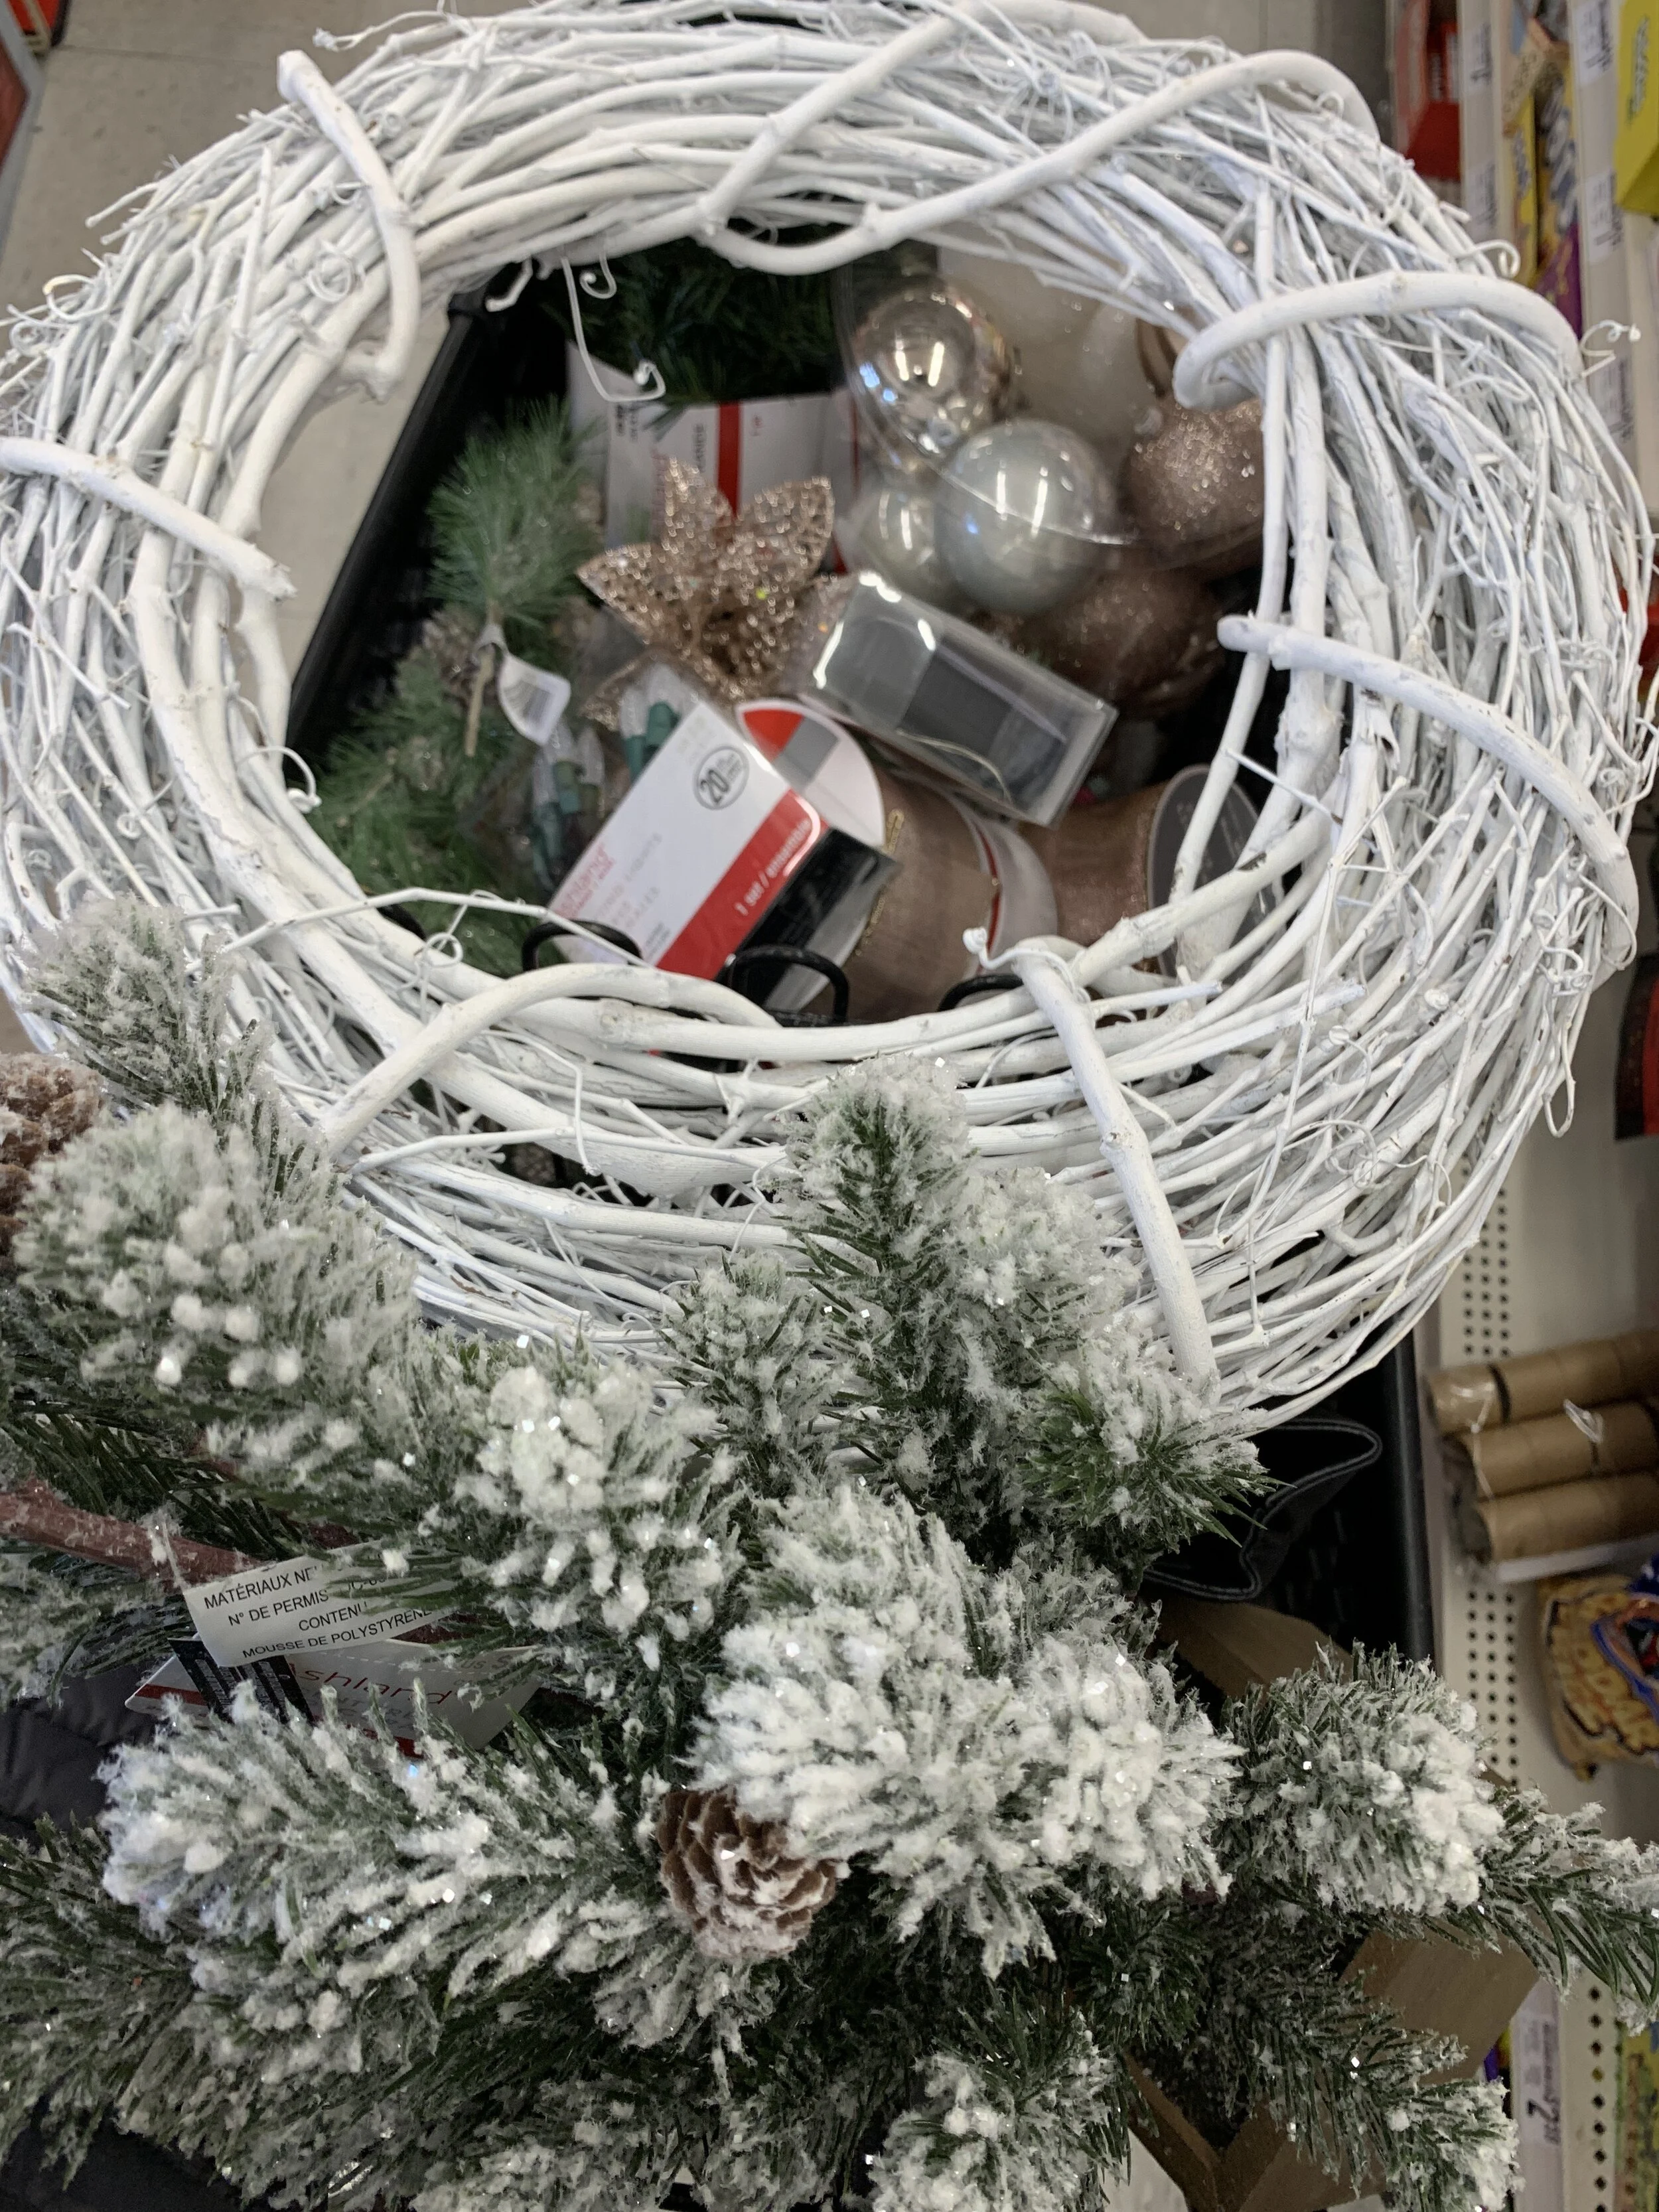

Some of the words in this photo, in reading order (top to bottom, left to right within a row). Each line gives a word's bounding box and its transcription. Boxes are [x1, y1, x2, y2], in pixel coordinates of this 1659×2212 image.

[700, 769, 729, 804] 20
[743, 881, 764, 907] set
[204, 1573, 293, 1609] MATÉRIAUX
[249, 1606, 271, 1621] DE
[273, 1589, 329, 1616] PERMIS
[242, 1640, 305, 1659] MOUSSE
[308, 1635, 329, 1647] DE
